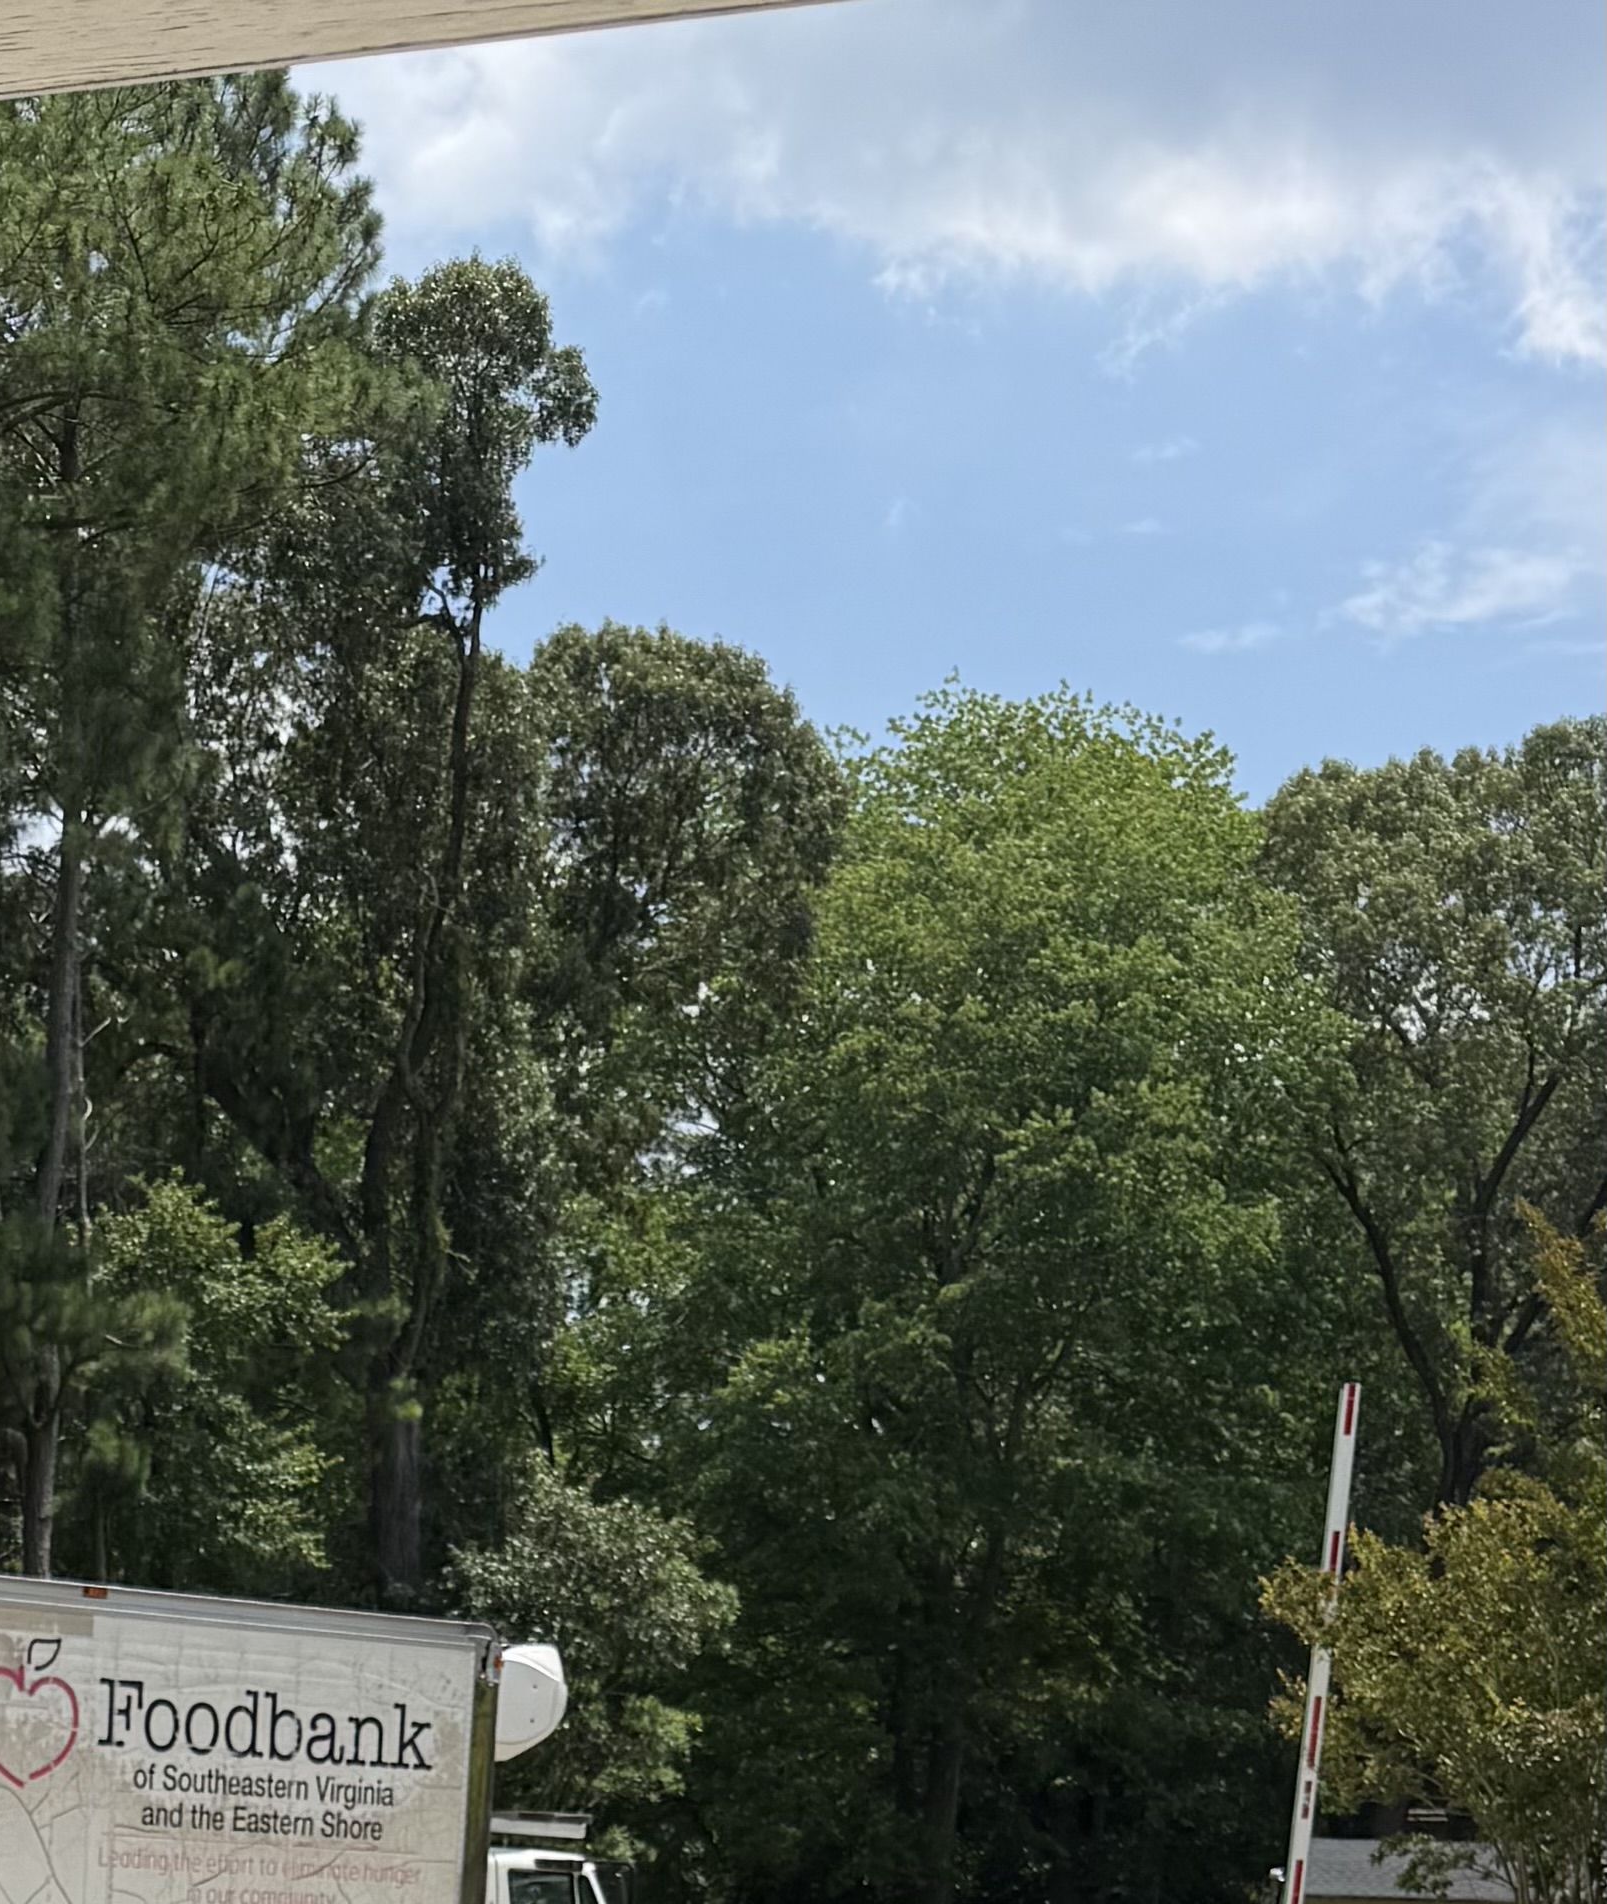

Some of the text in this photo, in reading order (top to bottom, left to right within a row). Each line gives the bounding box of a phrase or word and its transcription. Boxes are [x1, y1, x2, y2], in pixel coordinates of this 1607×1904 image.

[97, 1678, 433, 1771] Foodbank
[133, 1763, 394, 1811] of Southeastern Virginia
[141, 1803, 383, 1841] and the Eastern Shore
[97, 1846, 169, 1875] Leading
[173, 1848, 202, 1873] the
[259, 1855, 279, 1878] to
[362, 1861, 421, 1889] hunger
